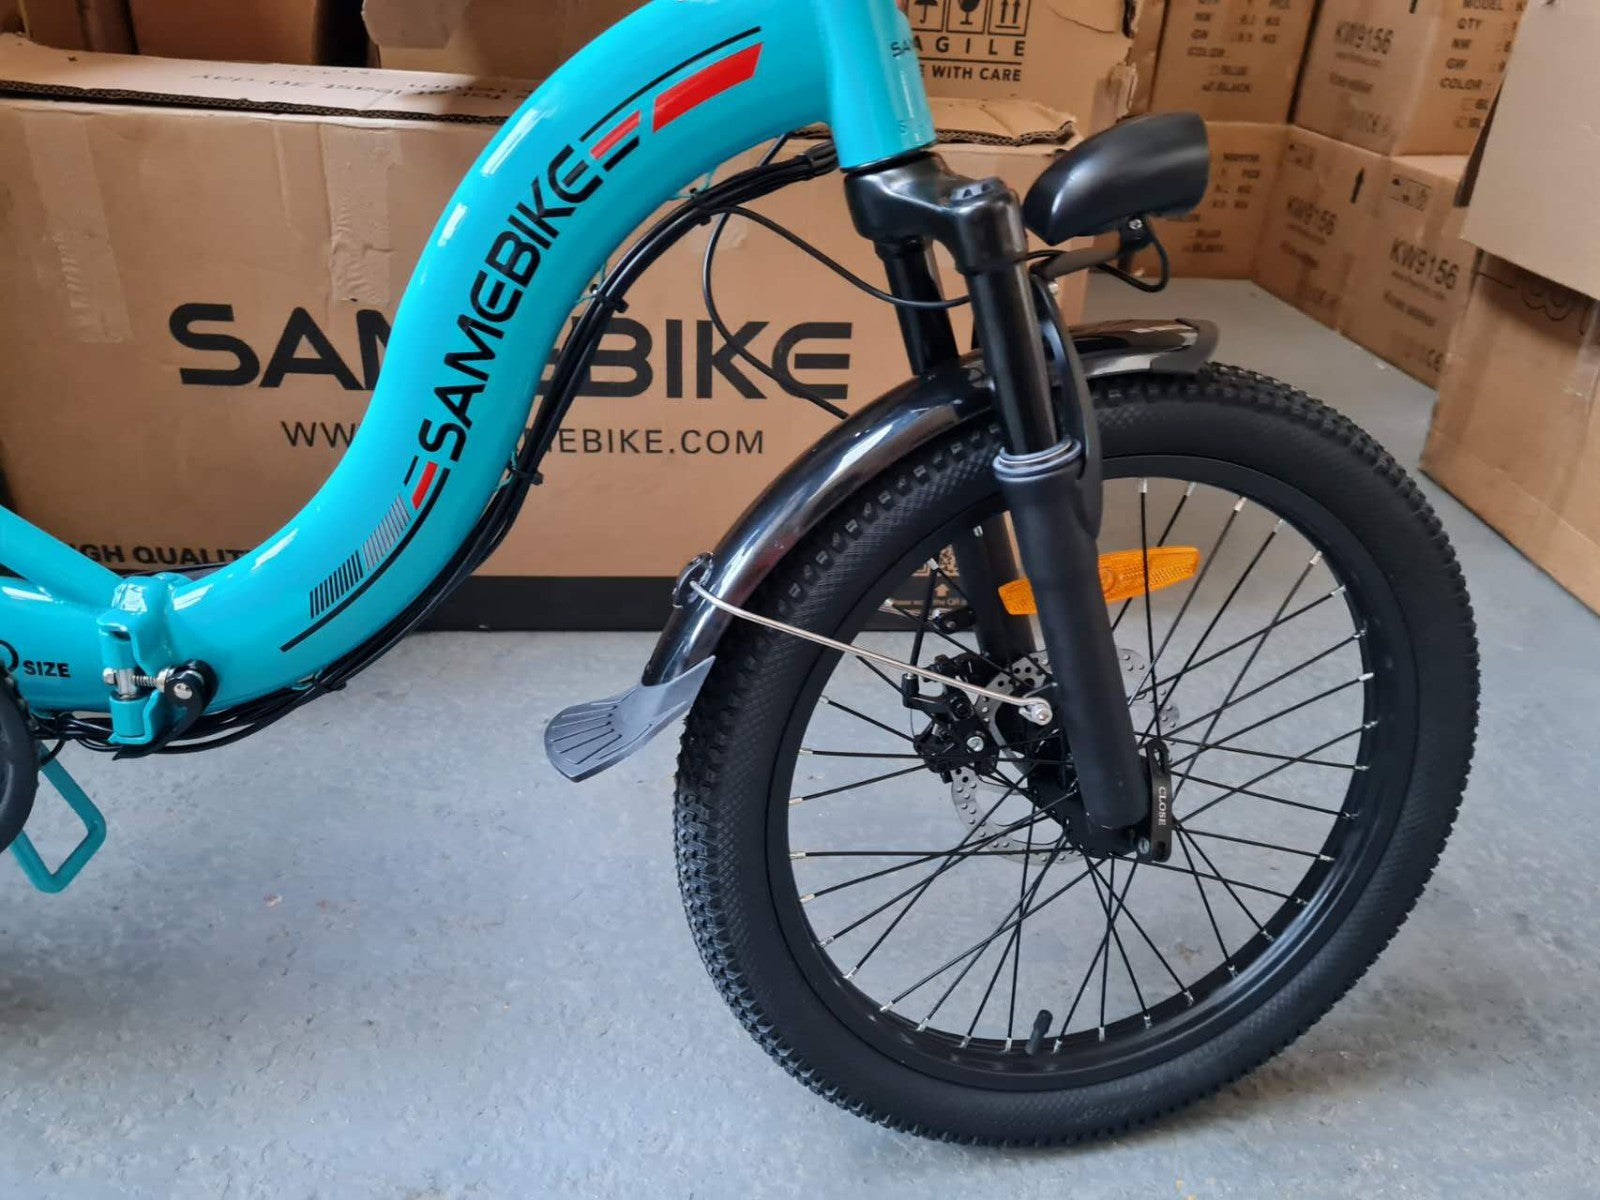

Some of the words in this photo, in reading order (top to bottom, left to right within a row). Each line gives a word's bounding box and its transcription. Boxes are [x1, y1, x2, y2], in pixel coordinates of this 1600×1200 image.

[912, 35, 1026, 57] AGILE
[932, 64, 973, 80] WITH
[980, 67, 1022, 82] CARE
[1439, 77, 1483, 90] COLOR
[1390, 238, 1460, 291] KW9156
[419, 144, 604, 463] SAMEBIKE
[169, 303, 853, 400] SABIKE
[23, 660, 71, 678] SIZE
[1158, 786, 1168, 826] CLOSE
